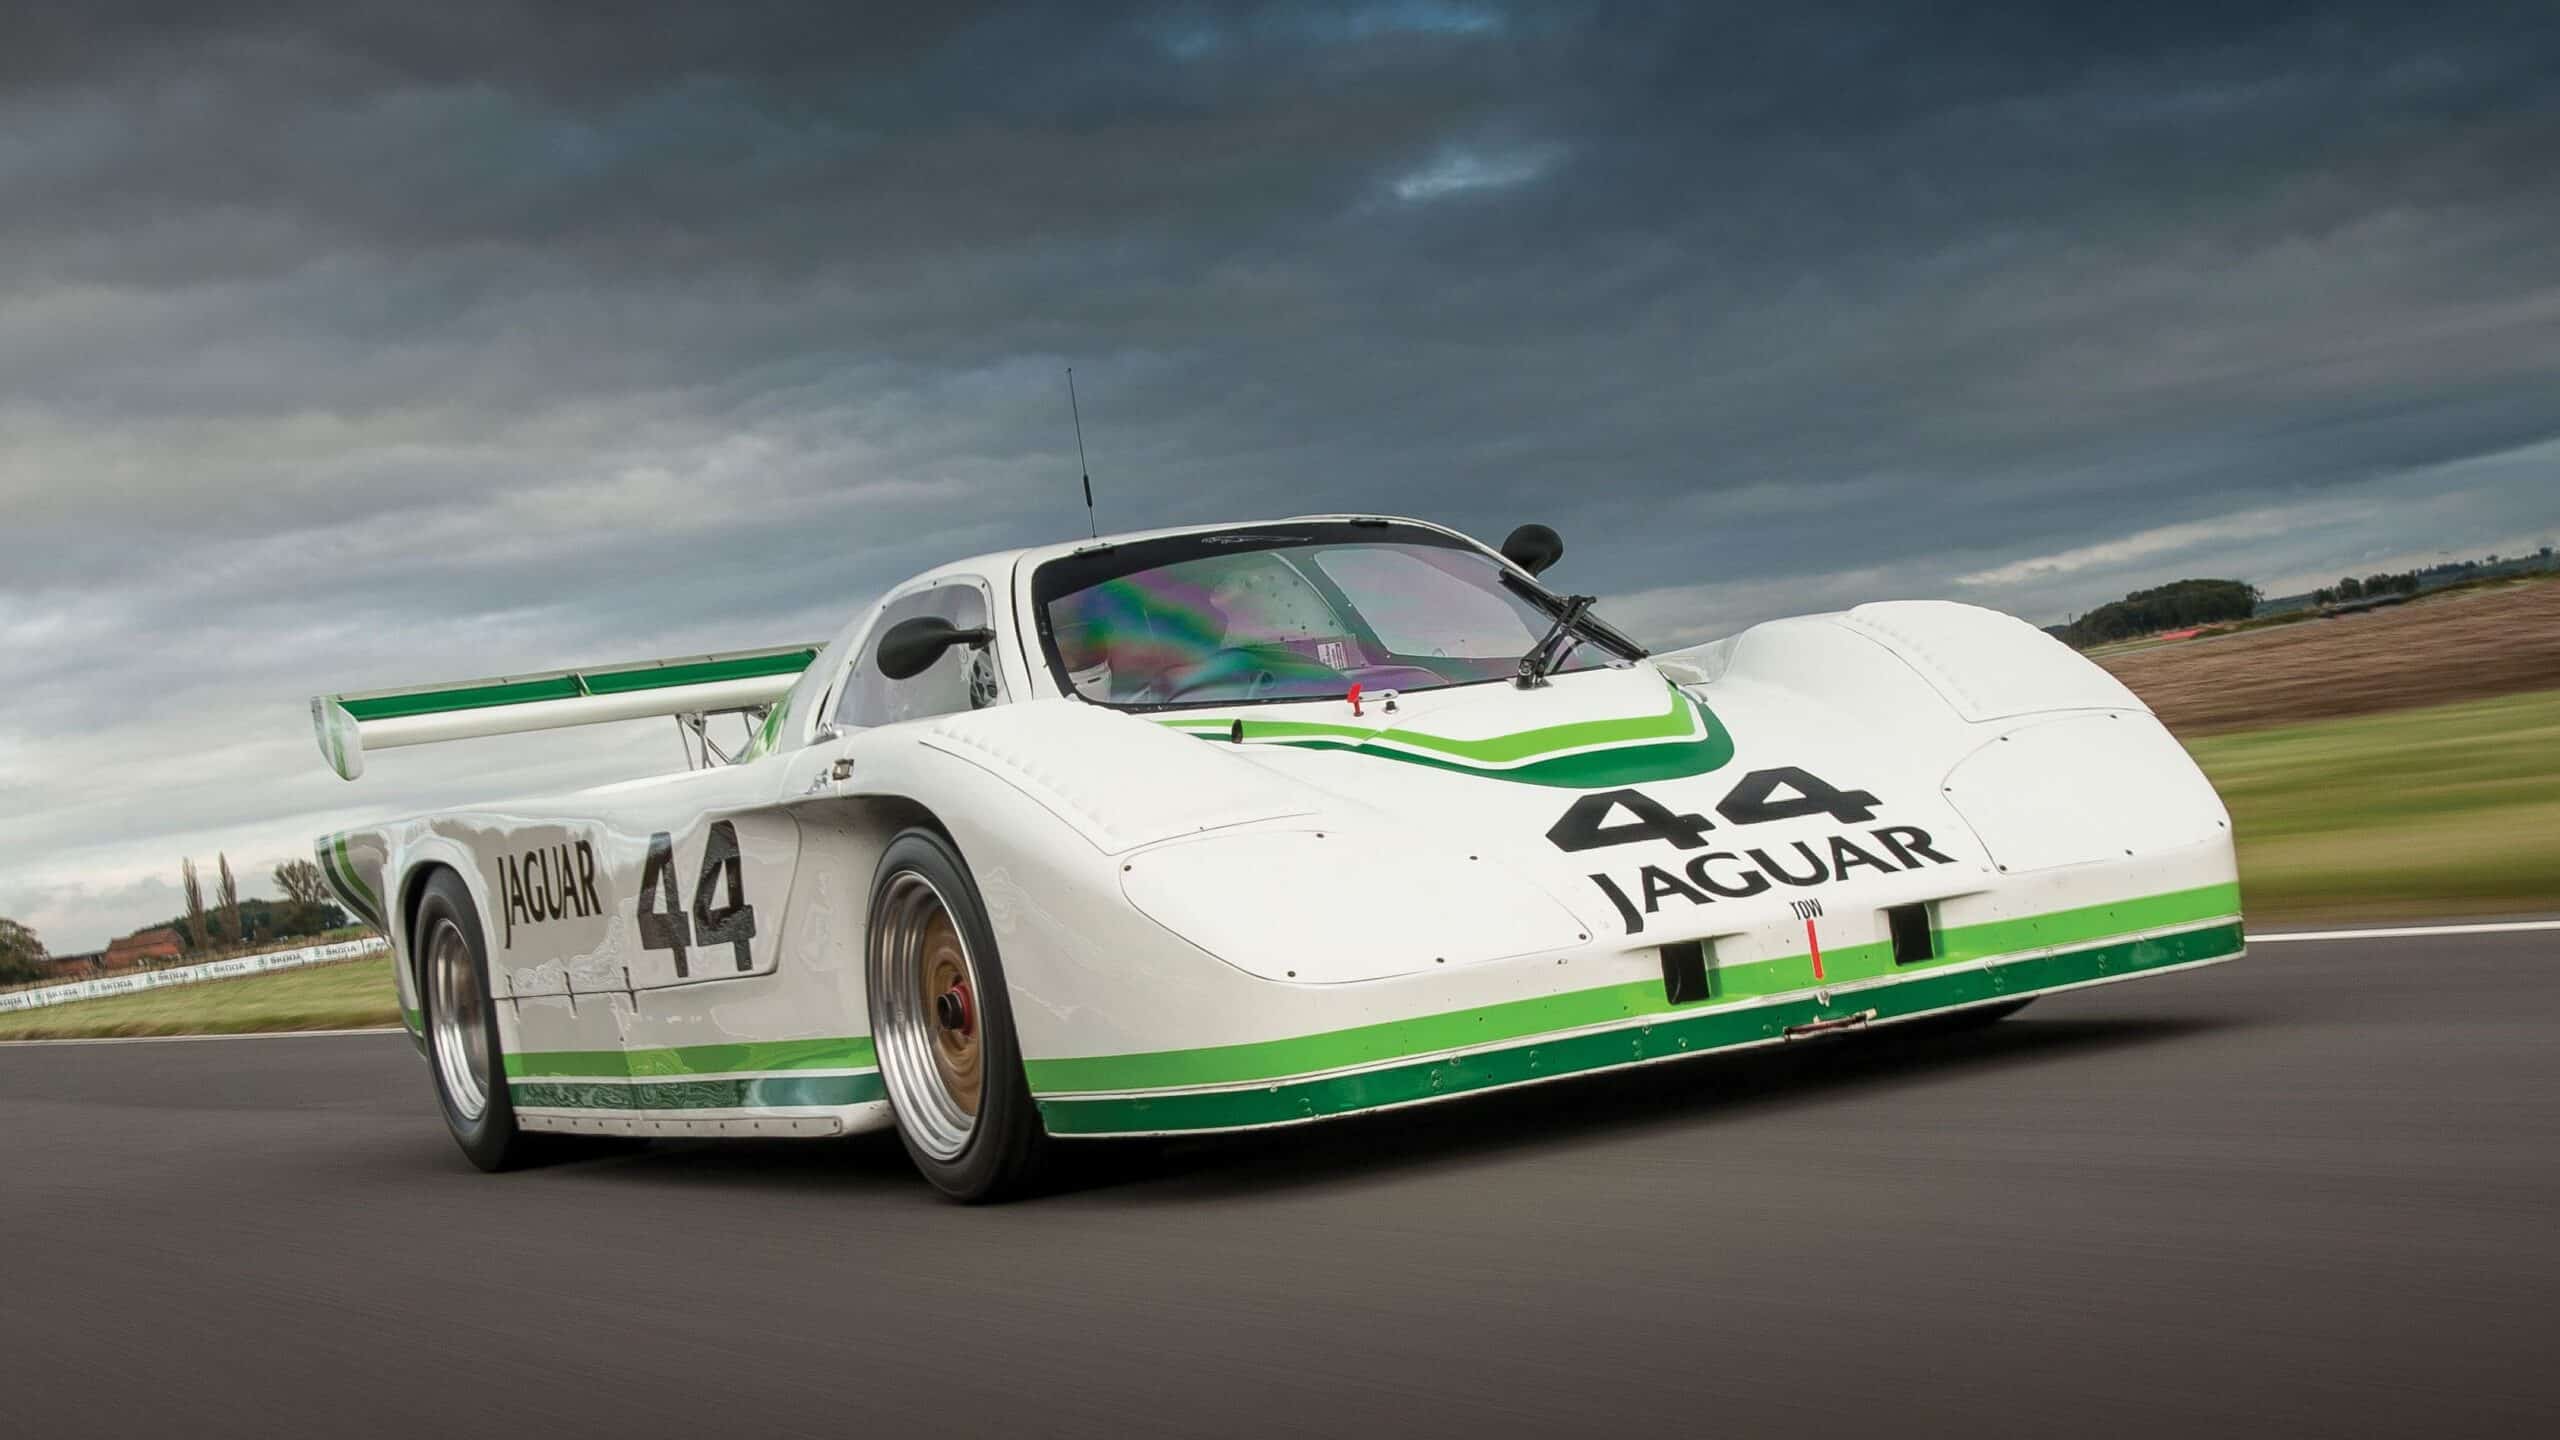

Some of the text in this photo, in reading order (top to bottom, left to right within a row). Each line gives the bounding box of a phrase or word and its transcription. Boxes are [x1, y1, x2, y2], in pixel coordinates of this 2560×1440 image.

[1545, 766, 1884, 853] 44
[497, 839, 602, 949] JAGUAR
[637, 819, 756, 978] 44
[1589, 825, 1958, 935] JAGUAR
[1789, 898, 1824, 921] TOW
